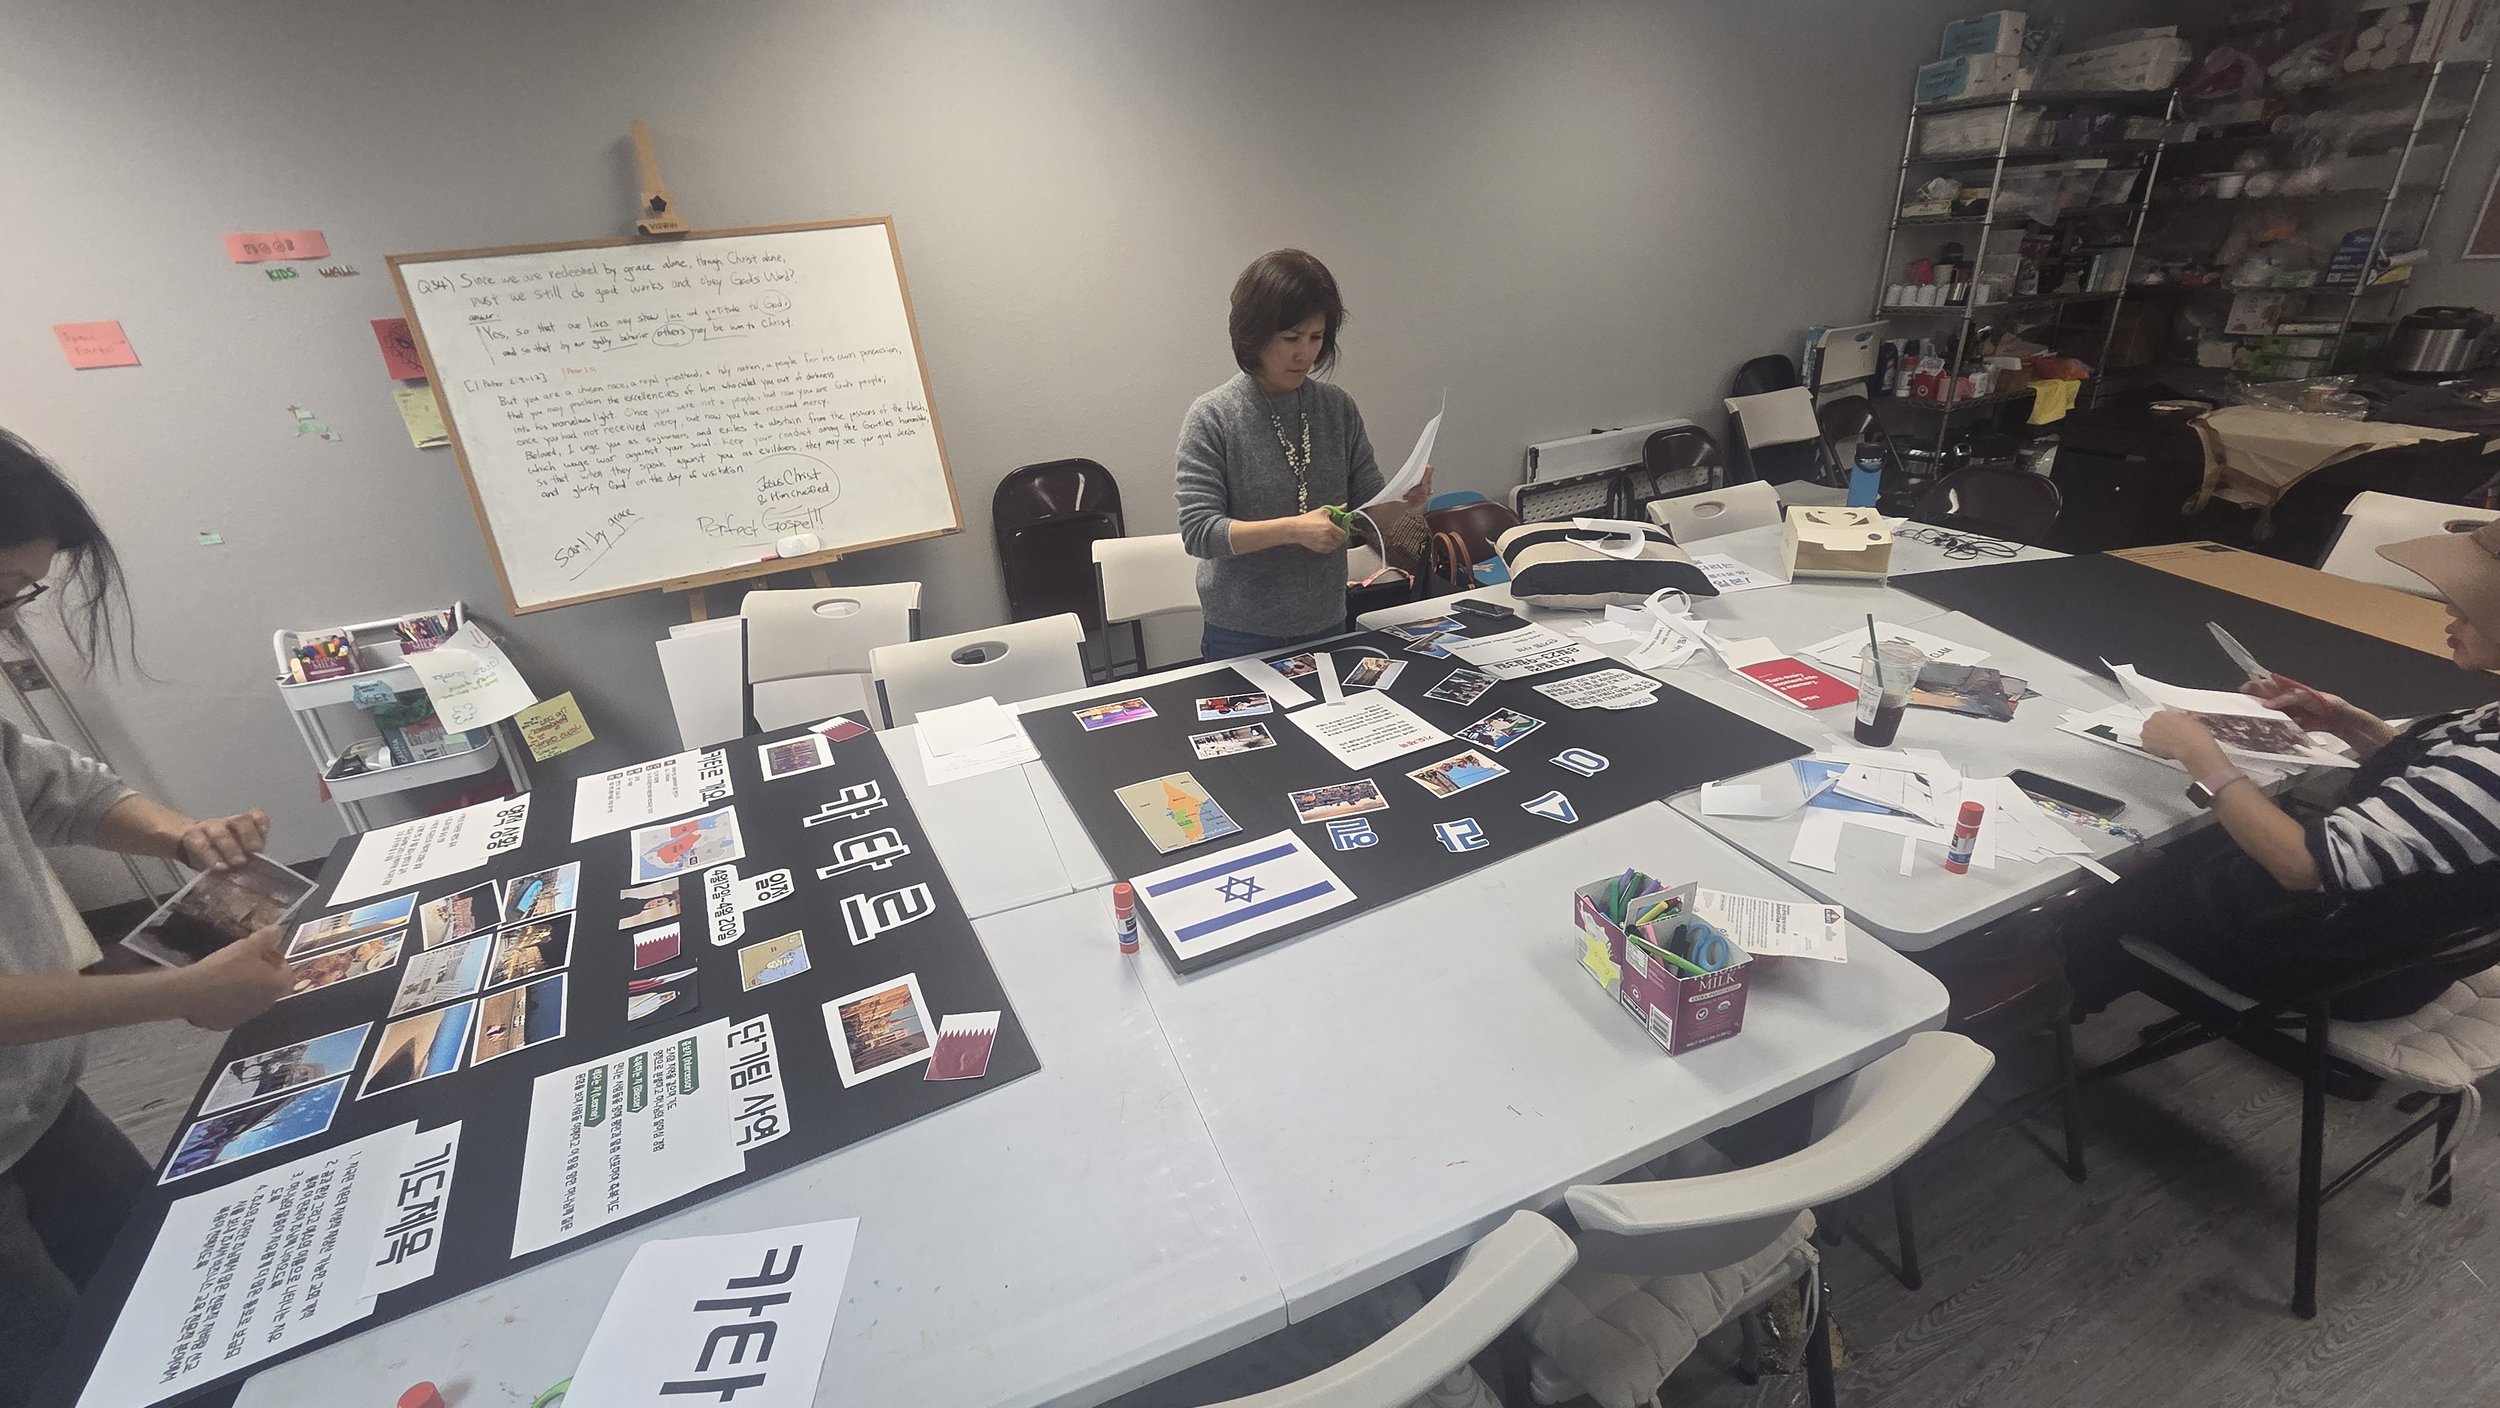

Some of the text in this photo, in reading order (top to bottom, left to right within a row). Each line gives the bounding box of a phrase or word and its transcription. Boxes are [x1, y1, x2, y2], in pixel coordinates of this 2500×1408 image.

[265, 267, 298, 281] KIDS
[460, 273, 496, 288] Since
[500, 275, 519, 284] we
[523, 272, 543, 282] are
[602, 262, 616, 282] by
[623, 264, 655, 282] grace
[726, 250, 758, 264] Christ
[509, 292, 526, 302] we
[534, 285, 562, 300] still
[571, 286, 584, 298] do
[595, 284, 619, 302] good
[630, 281, 664, 294] works
[672, 276, 691, 288] and
[515, 328, 530, 336] so
[537, 322, 555, 333] that
[586, 316, 609, 328] lives
[502, 347, 517, 356] and
[533, 342, 551, 352] that
[560, 341, 570, 353] by
[655, 326, 686, 337] others
[497, 395, 517, 406] But
[523, 396, 540, 406] you
[804, 352, 818, 364] for
[507, 410, 524, 420] that
[607, 396, 619, 404] the
[699, 384, 716, 393] him
[760, 379, 774, 389] you
[776, 376, 789, 384] out
[516, 412, 740, 446] once had not received you
[535, 422, 548, 430] his
[624, 409, 648, 417] Once
[696, 427, 712, 436] and
[527, 463, 556, 474] which
[596, 454, 616, 464] war
[551, 474, 569, 483] that
[580, 470, 602, 480] when
[610, 466, 631, 481] they
[782, 467, 821, 485] Christ
[541, 487, 559, 498] and
[649, 473, 664, 483] the
[608, 508, 637, 537] grace
[697, 513, 759, 538] Perfect
[313, 660, 339, 670] MILK
[697, 750, 727, 803] 카타르 개요
[486, 804, 526, 850] 영적 상황
[804, 781, 936, 945] 카타르
[755, 871, 788, 902] 일정
[1699, 972, 1735, 991] MILK
[727, 1021, 780, 1147] 단기팀 사역
[666, 1096, 676, 1110] 기도
[306, 1201, 324, 1225] 그리고
[376, 1142, 452, 1267] 기도제목
[657, 1243, 805, 1404] 카타
